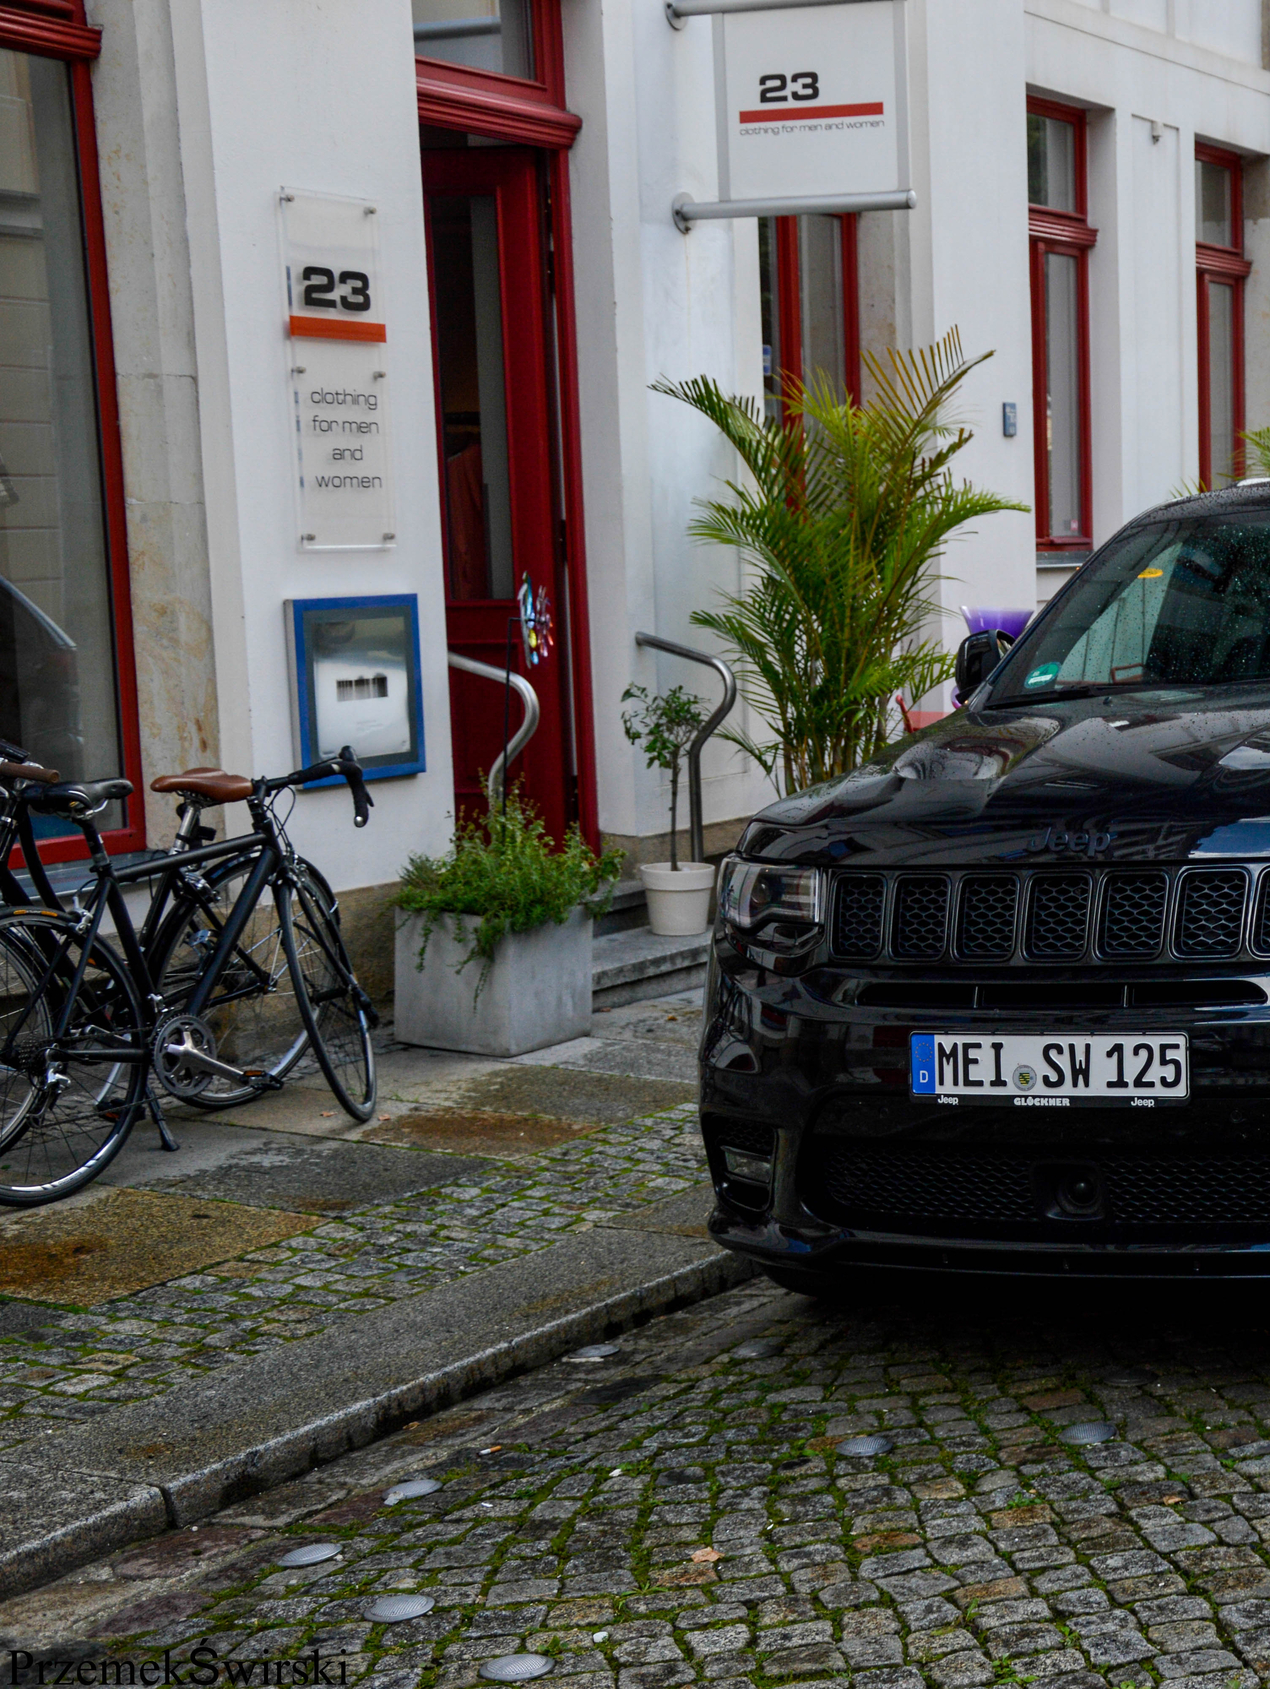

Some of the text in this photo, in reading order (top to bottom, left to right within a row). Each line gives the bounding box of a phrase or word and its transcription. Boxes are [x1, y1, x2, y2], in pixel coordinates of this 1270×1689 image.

[759, 71, 820, 103] 23
[739, 119, 885, 136] clothing for men and women
[302, 266, 371, 312] 23
[310, 387, 378, 411] clothing
[311, 415, 379, 434] for men
[332, 445, 363, 461] and
[315, 475, 382, 489] women
[1026, 827, 1111, 857] Jeep
[937, 1041, 1008, 1087] MEI
[1042, 1042, 1091, 1088] SW
[1105, 1042, 1182, 1089] 125
[919, 1071, 929, 1083] D
[938, 1095, 959, 1106] Jeep
[1131, 1097, 1155, 1107] Jeep
